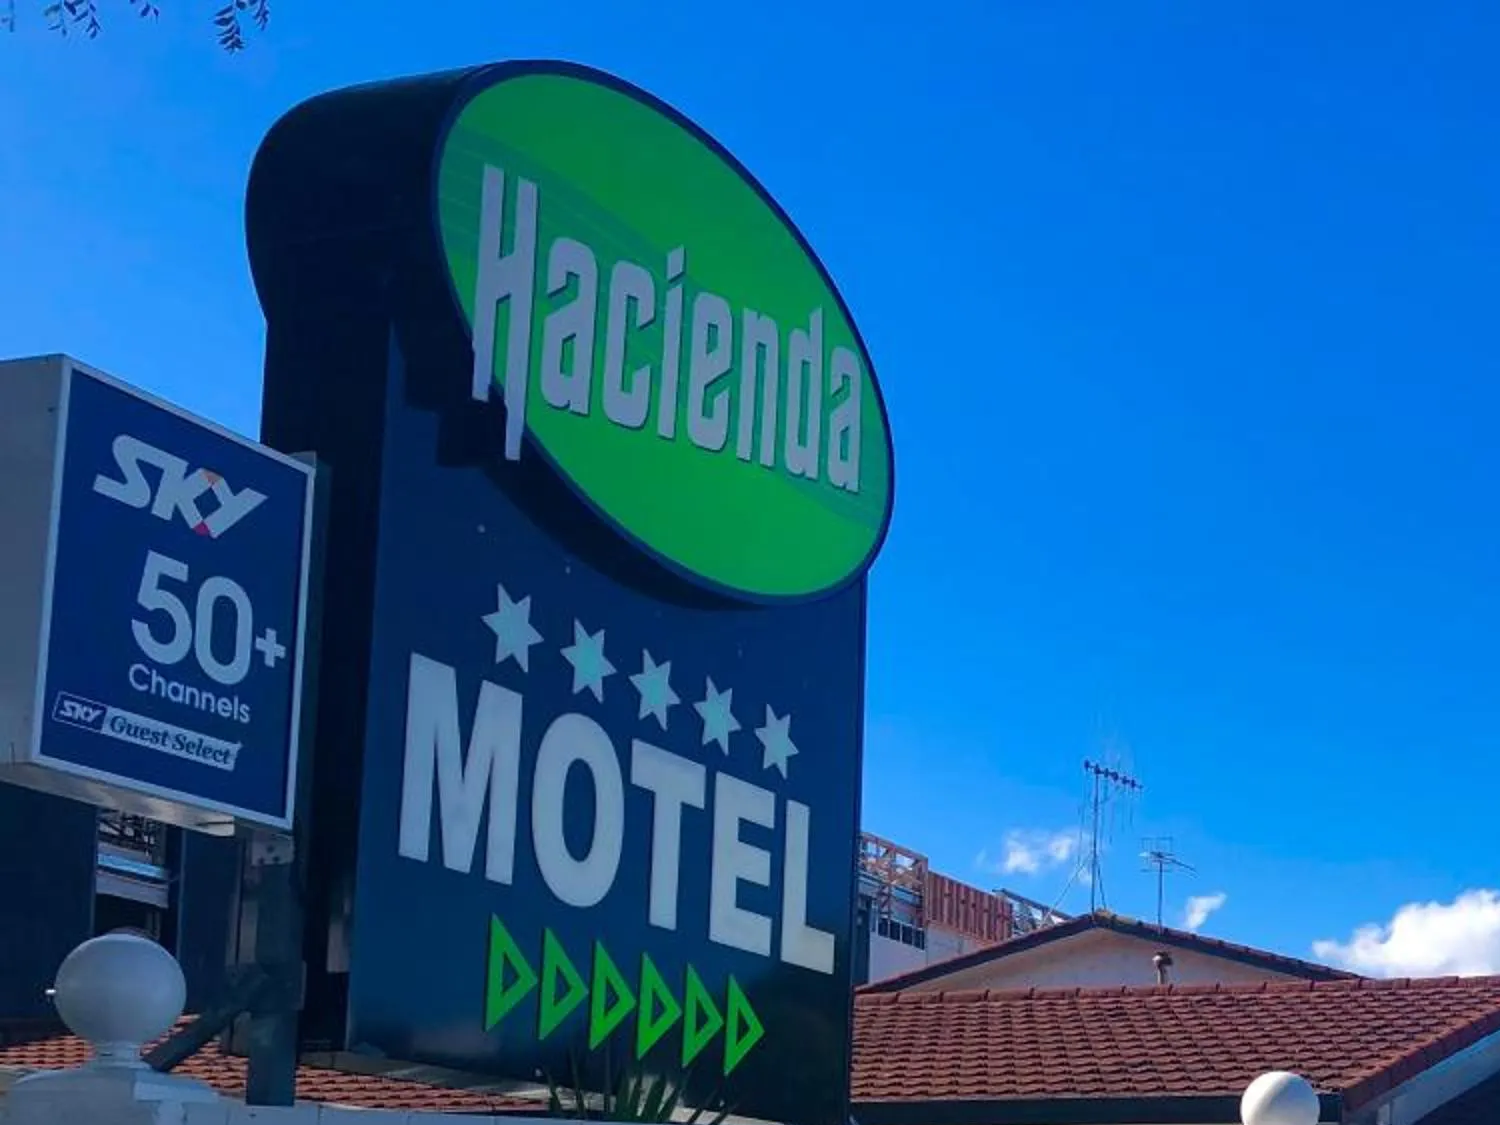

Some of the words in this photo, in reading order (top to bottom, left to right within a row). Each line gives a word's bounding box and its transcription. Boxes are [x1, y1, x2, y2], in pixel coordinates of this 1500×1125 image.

[471, 162, 862, 493] Hacienda
[92, 433, 269, 539] SKY
[130, 549, 287, 685] 50+
[110, 714, 173, 748] Guest
[171, 732, 231, 765] Select
[128, 662, 251, 724] Channels
[398, 651, 835, 975] MOTEL
